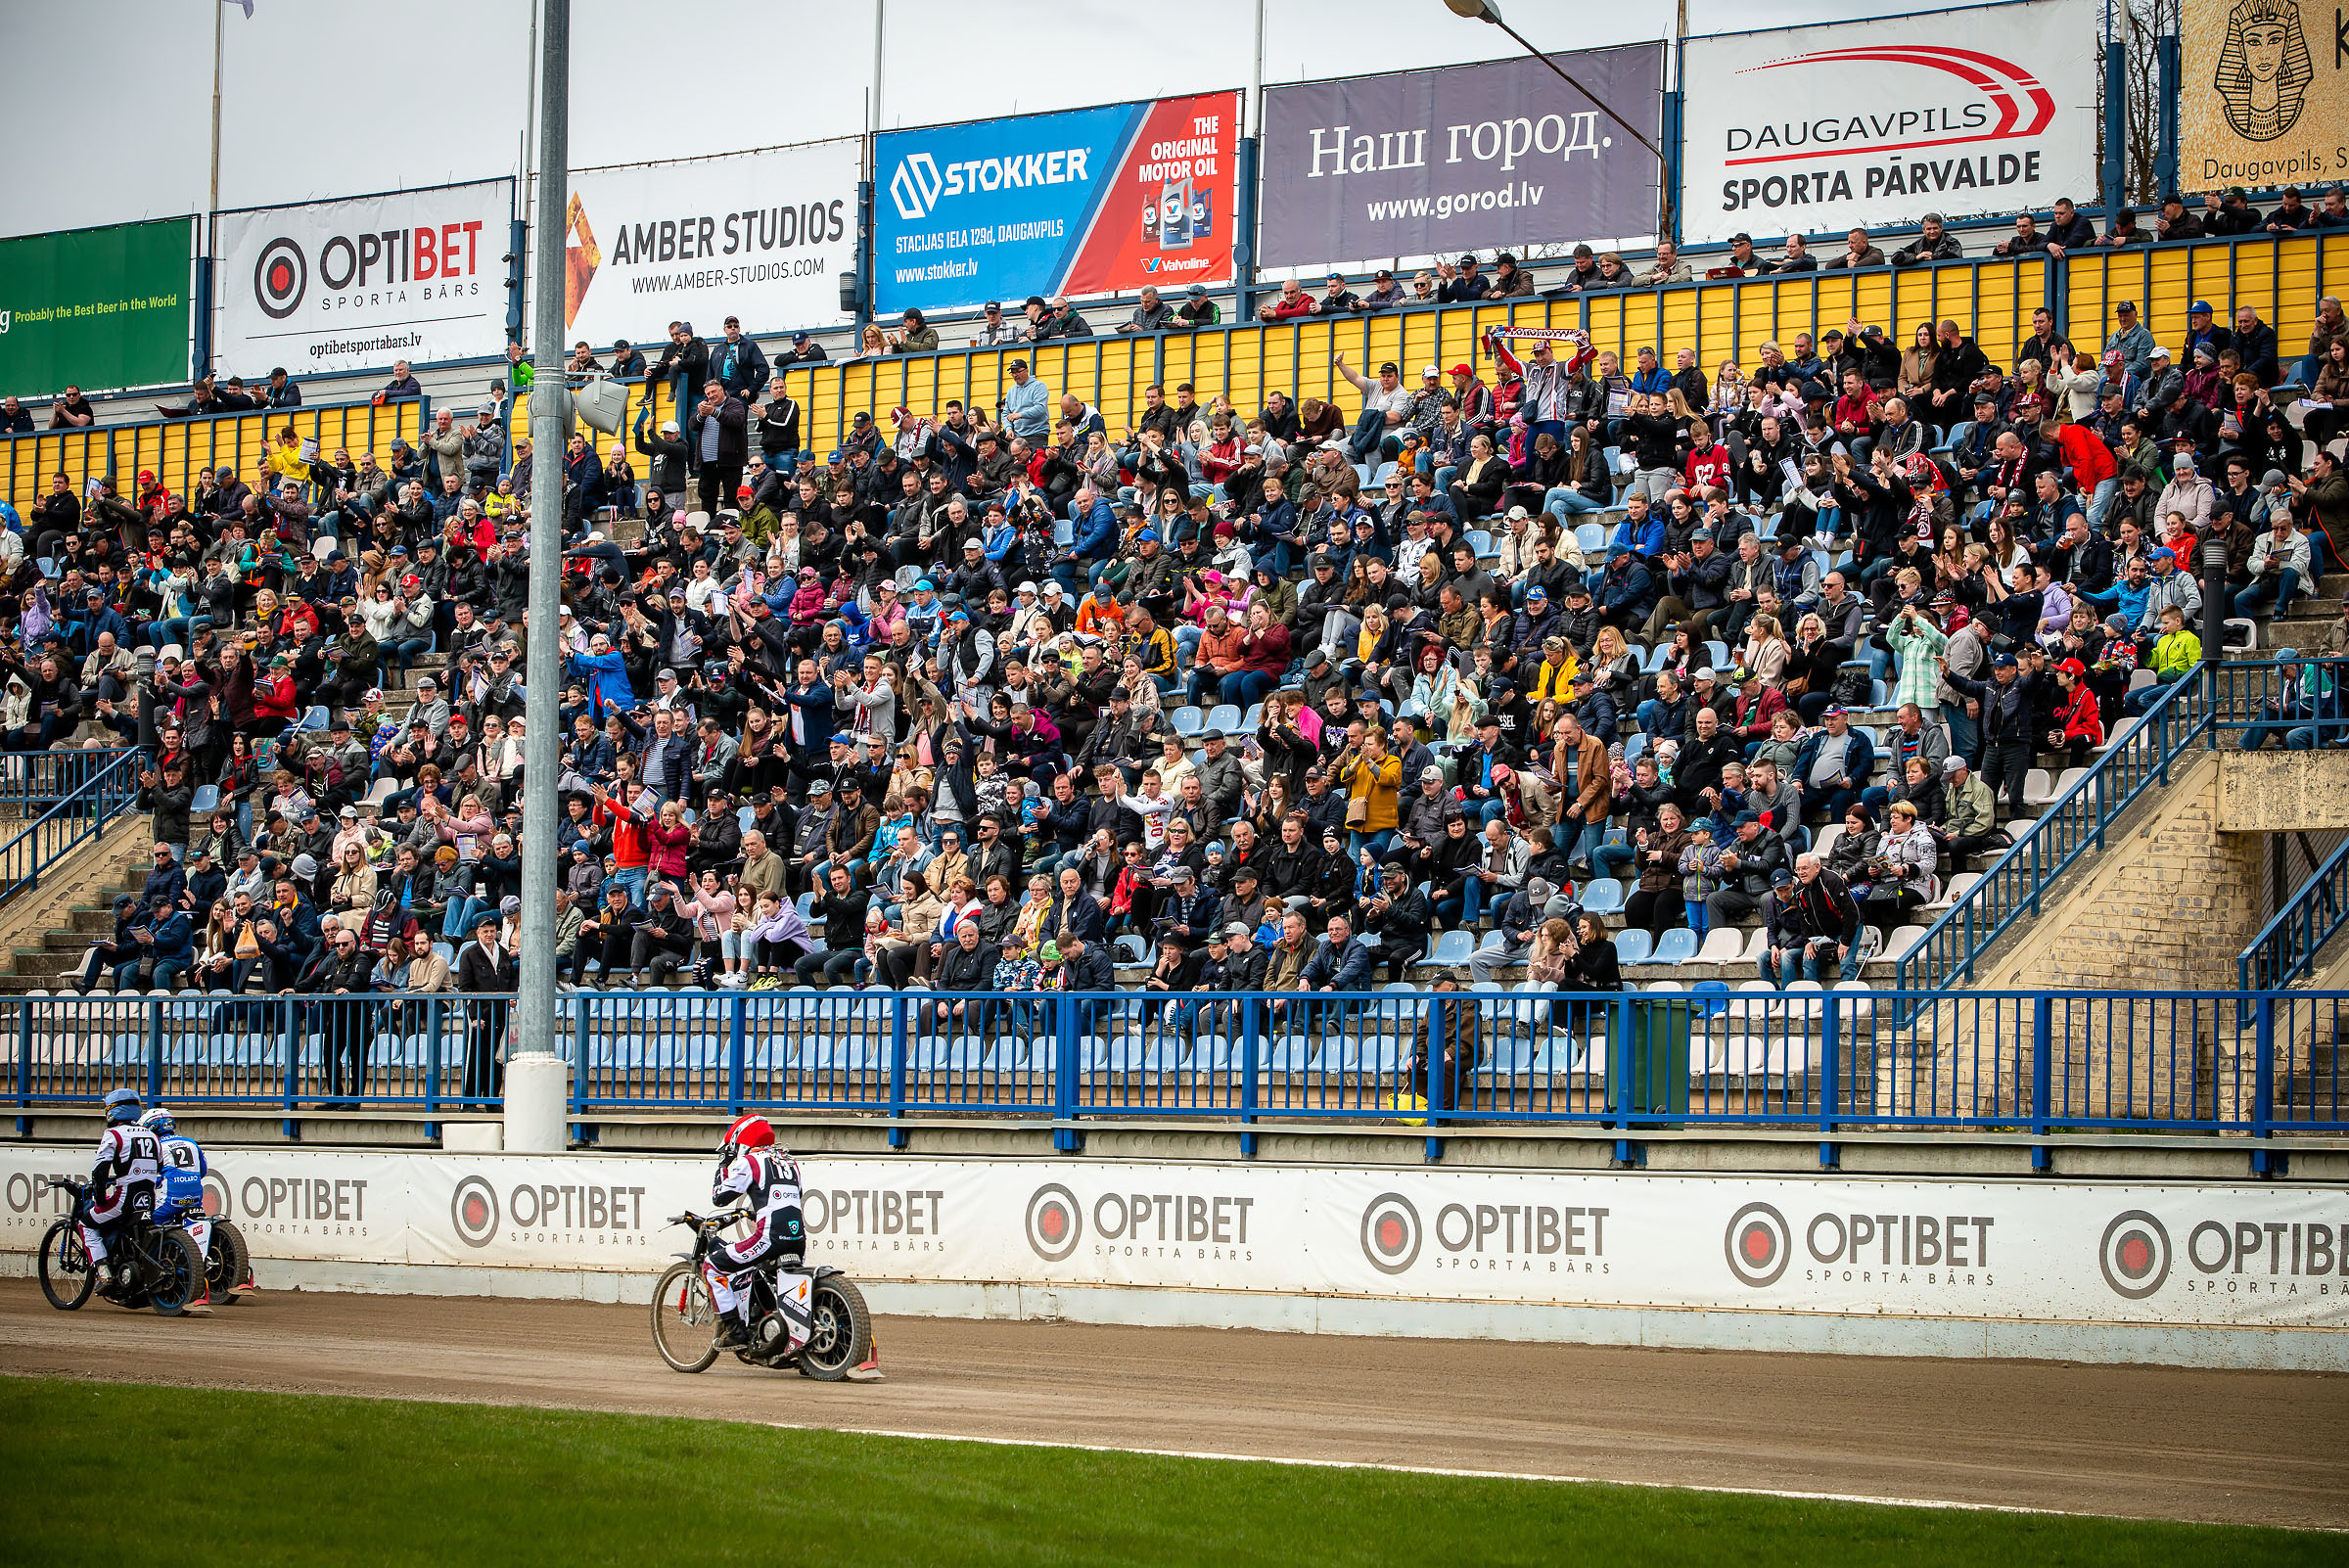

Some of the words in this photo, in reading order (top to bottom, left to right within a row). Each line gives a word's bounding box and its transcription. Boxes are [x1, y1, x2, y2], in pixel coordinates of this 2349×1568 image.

[1193, 115, 1220, 136] THE
[1727, 103, 1987, 153] DAUGAVPILS
[1150, 136, 1219, 161] ORIGINAL
[1307, 125, 1427, 178] Наш
[1445, 111, 1612, 171] город.
[943, 148, 1089, 196] STOKKER
[1138, 160, 1192, 183] MOTOR
[1194, 157, 1219, 177] OIL
[2204, 149, 2328, 182] Daugavpils,
[1722, 169, 1853, 211] SPORTA
[1865, 150, 2041, 199] PĀRVALDE
[1366, 180, 1544, 221] www.gorod.lv
[611, 215, 716, 266] AMBER
[722, 199, 845, 255] STUDIOS
[896, 232, 944, 254] STACIJAS
[945, 229, 969, 249] IELA
[970, 226, 996, 247] 129d,
[997, 218, 1065, 244] DAUGAVPILS
[319, 220, 483, 291] OPTIBET
[1161, 257, 1213, 272] Valvoline
[631, 256, 825, 295] WWW.AMBER-STUDIOS.COM
[895, 257, 979, 284] www.stokker.lv
[15, 306, 55, 323] Probably
[56, 305, 72, 318] the
[74, 303, 95, 316] Best
[97, 301, 118, 314] Beer
[119, 300, 128, 312] in
[130, 298, 147, 310] the
[149, 293, 177, 308] World
[321, 290, 407, 311] SPORTA
[423, 282, 480, 300] BĀRS
[309, 332, 423, 359] optibetsportabars.lv
[1695, 463, 1716, 486] 82
[137, 1138, 154, 1158] 12
[176, 1148, 189, 1165] 2
[775, 1162, 794, 1179] 13
[241, 1176, 368, 1222] OPTIBET
[510, 1183, 646, 1230] OPTIBET
[802, 1188, 944, 1235] OPTIBET
[7, 1217, 59, 1228] SPOR
[242, 1222, 310, 1234] SPORTA
[323, 1223, 368, 1237] BĀRS
[1093, 1192, 1255, 1244] OPTIBET
[1436, 1203, 1610, 1257] OPTIBET
[511, 1232, 585, 1244] SPORTA
[598, 1232, 647, 1246] BĀRS
[812, 1239, 878, 1251] PORTA
[894, 1239, 944, 1252] BĀRS
[1806, 1212, 1995, 1268] OPTIBET
[1095, 1245, 1181, 1259] SPORTA
[1198, 1246, 1253, 1262] BĀRS
[1436, 1258, 1531, 1272] SPORTA
[1549, 1259, 1610, 1274] BĀRS
[1806, 1269, 1909, 1284] SPORTA
[1928, 1268, 1994, 1286] BĀRS
[2188, 1280, 2298, 1295] SPORTA
